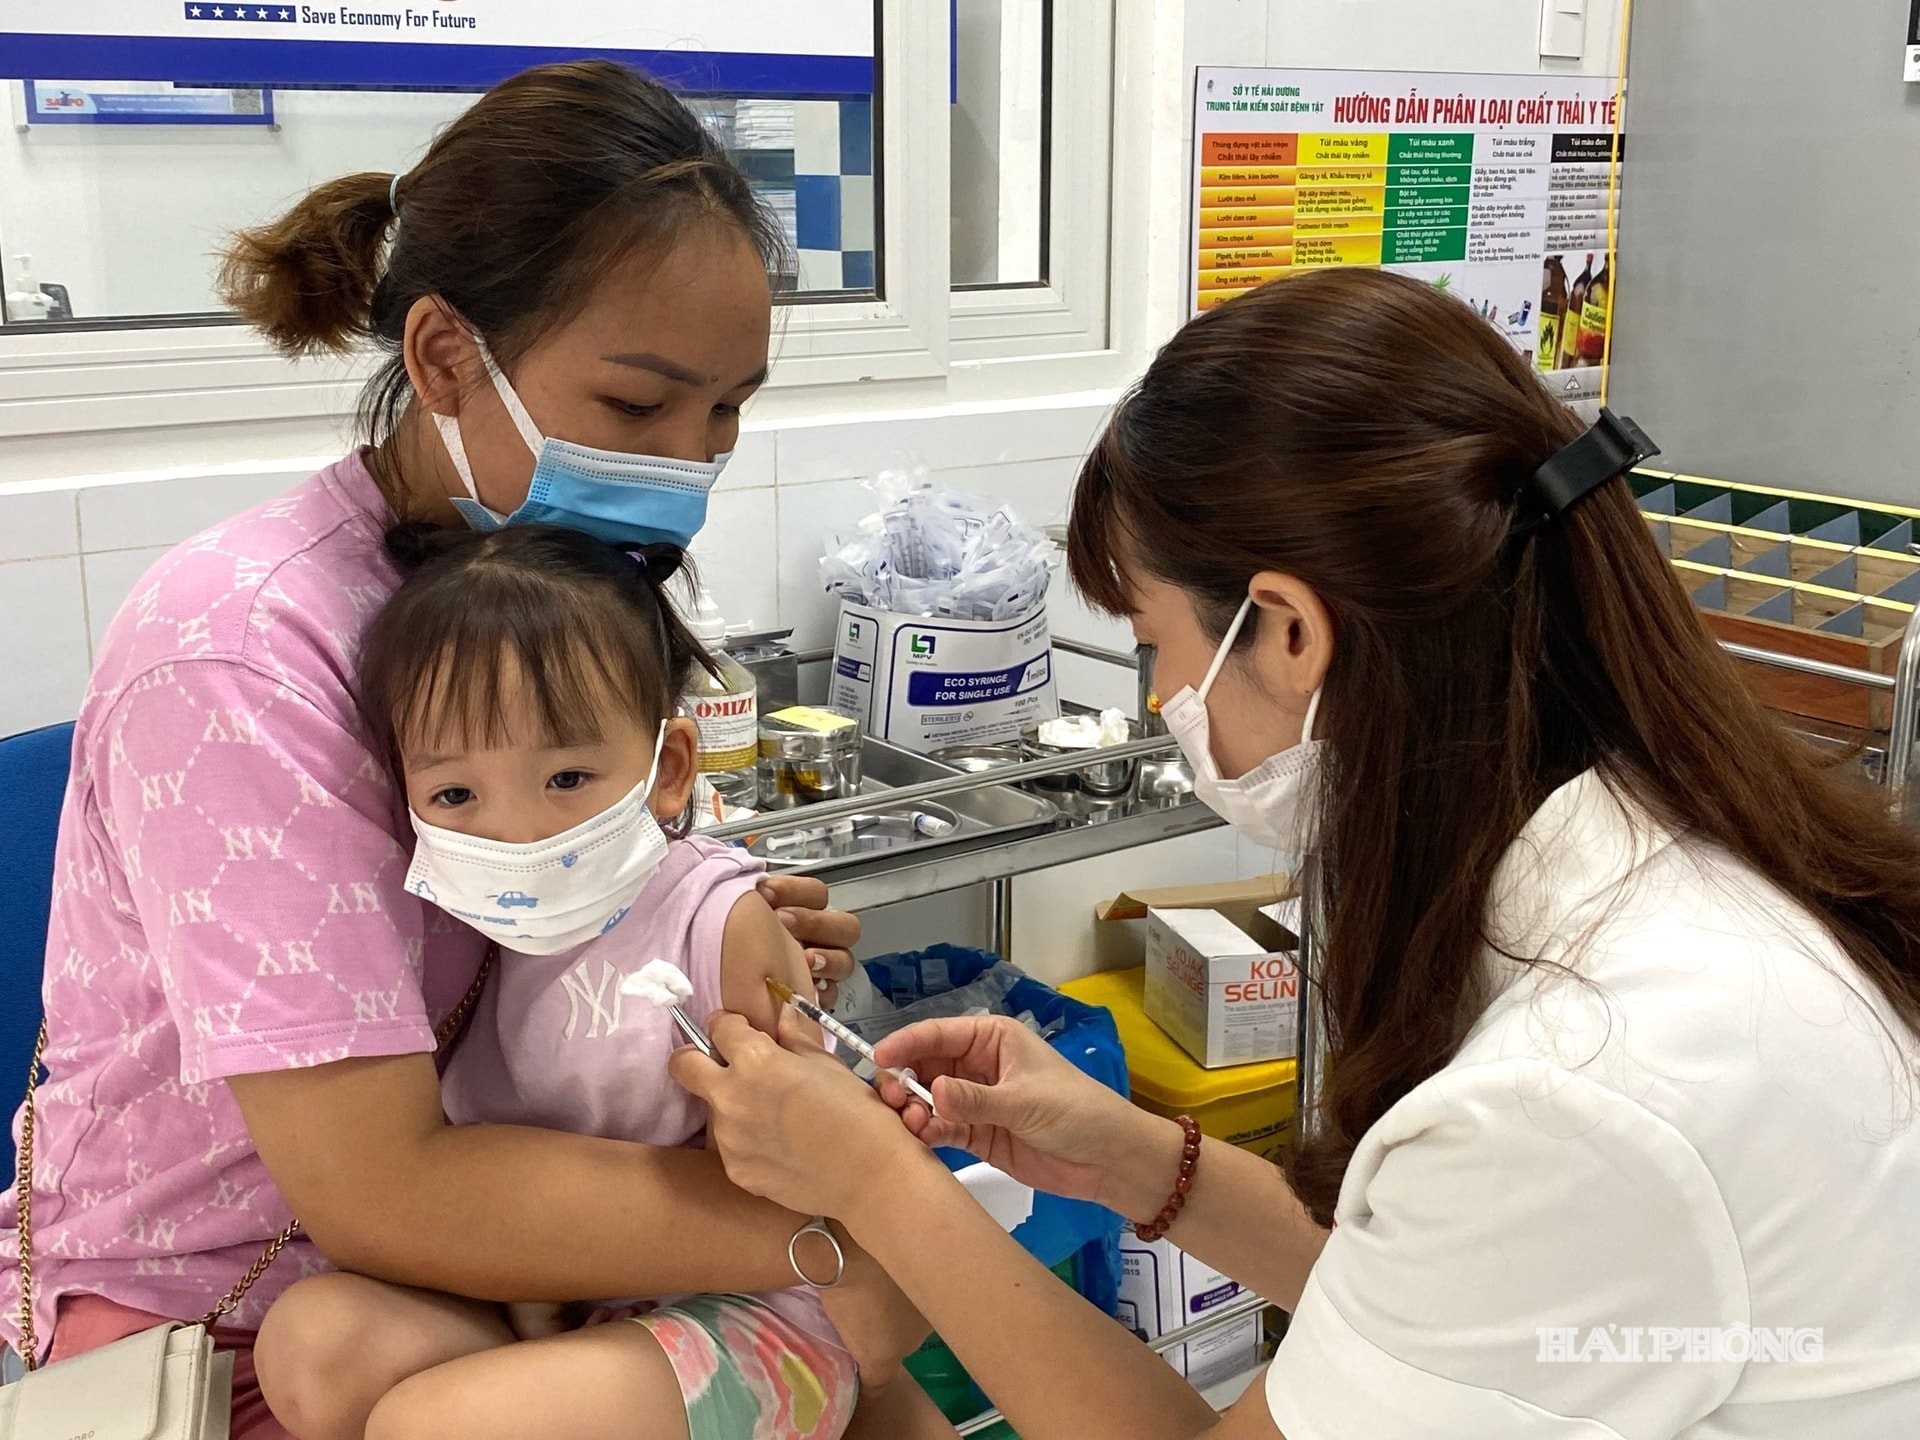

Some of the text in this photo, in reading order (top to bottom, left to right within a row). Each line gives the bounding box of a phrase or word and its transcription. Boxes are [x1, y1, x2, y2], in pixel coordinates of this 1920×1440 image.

[302, 6, 476, 29] Save Economy For Future
[1233, 84, 1300, 96] SỞ Y TẾ HẢI DƯƠNG
[1206, 99, 1324, 114] TRUNG TÂM KIỂM SOÁT BỆNH TẬT
[1334, 88, 1618, 129] HƯỚNG DẪN PHÂN LOẠI CHẤT THẢI Y TẾ
[1409, 138, 1420, 146] Túi
[944, 674, 1008, 687] ECO SYRINGE
[935, 685, 1011, 701] FOR SINGLE USE
[142, 773, 187, 812] NY
[223, 826, 287, 862] NY
[1251, 960, 1297, 980] KOJ
[1224, 980, 1297, 1002] SELIN
[351, 990, 401, 1022] NY
